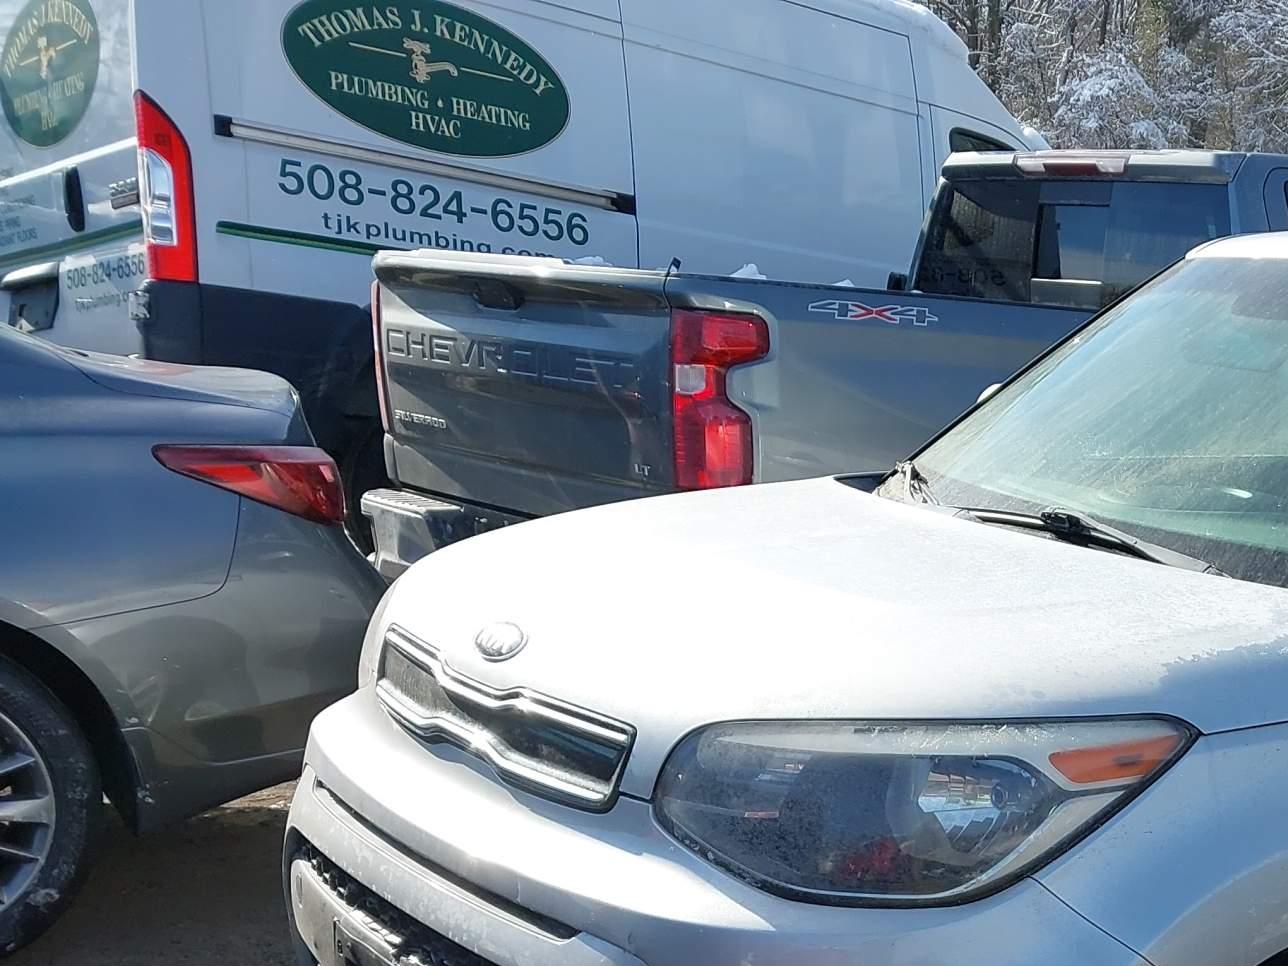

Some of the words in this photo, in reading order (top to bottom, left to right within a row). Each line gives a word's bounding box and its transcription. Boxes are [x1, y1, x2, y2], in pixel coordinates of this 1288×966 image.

[298, 6, 402, 48] THOMAS
[410, 9, 429, 33] J.
[433, 14, 555, 96] KENNEDY
[329, 70, 429, 109] PLUMBING
[450, 97, 531, 131] HEATING
[410, 110, 462, 139] HVAC
[278, 158, 590, 246] 508-824-6556
[67, 252, 145, 290] 508-824-6556
